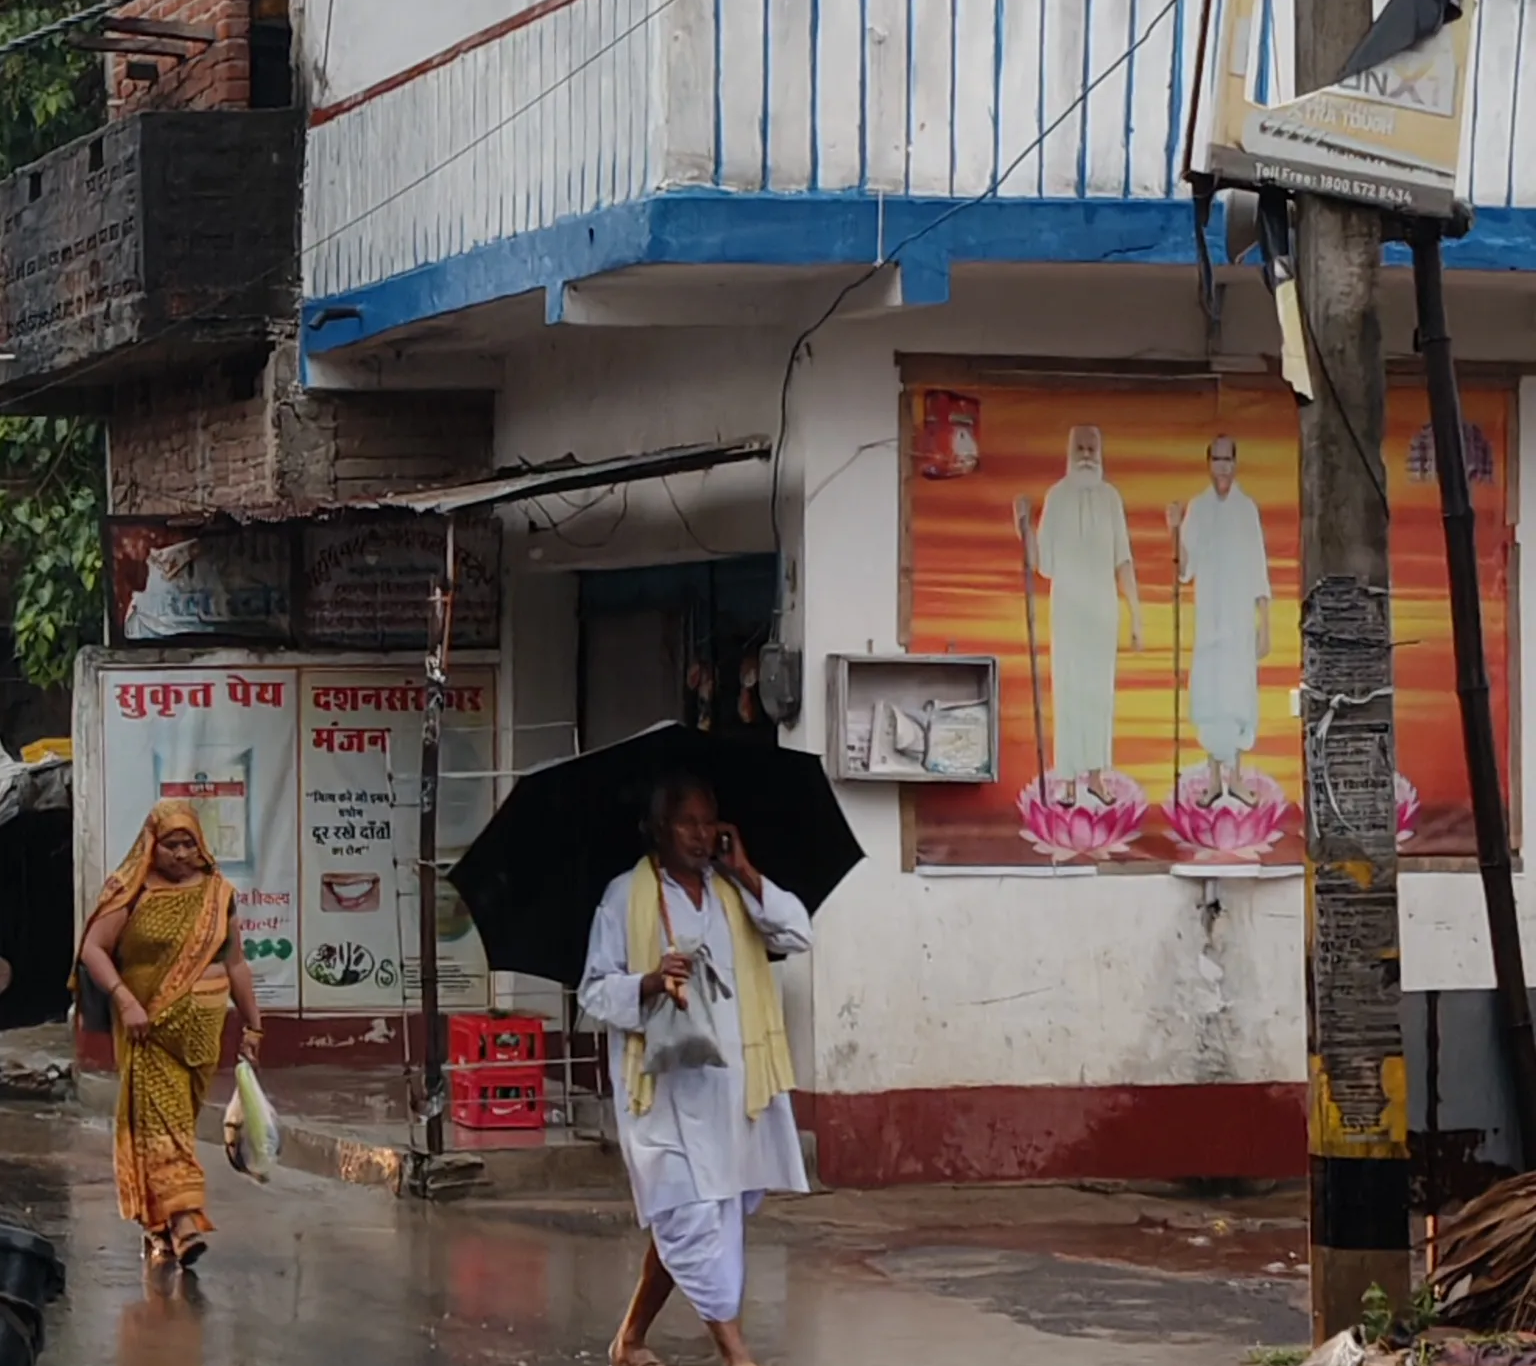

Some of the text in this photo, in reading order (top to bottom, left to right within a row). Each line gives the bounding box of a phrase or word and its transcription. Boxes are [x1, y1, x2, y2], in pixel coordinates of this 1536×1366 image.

[1255, 162, 1280, 178] Toll
[113, 674, 285, 719] सुकृत पेय
[311, 721, 391, 754] मंजन
[311, 825, 330, 845] दूर
